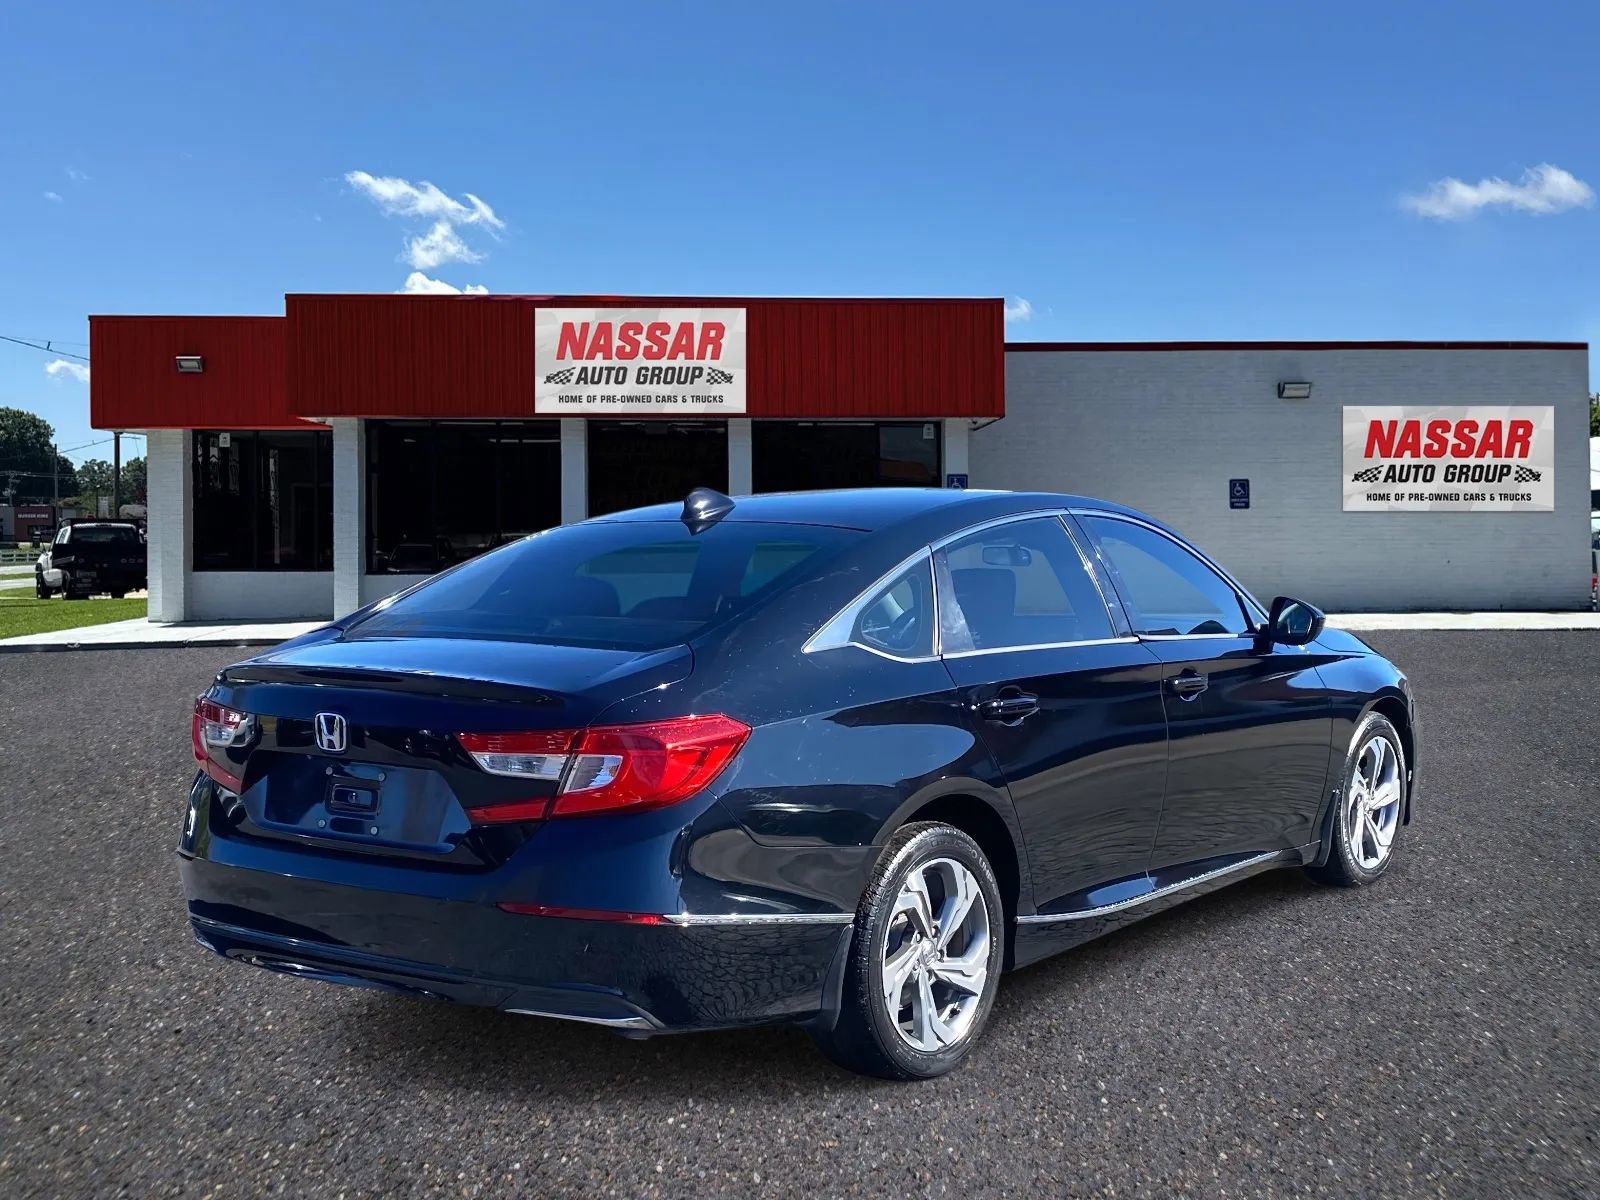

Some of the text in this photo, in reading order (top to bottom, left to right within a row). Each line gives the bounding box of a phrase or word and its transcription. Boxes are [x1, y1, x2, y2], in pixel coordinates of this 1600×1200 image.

[555, 321, 726, 361] NASSAR
[575, 366, 703, 385] AUTO GROUP
[558, 394, 724, 404] HOME OF PRE-OWNED CARS & TRUCKS
[1363, 419, 1534, 459] NASSAR
[1383, 464, 1512, 483] AUTO GROUP
[1366, 492, 1532, 502] HOME OF PRE-OWNED CARS & TRUCKS
